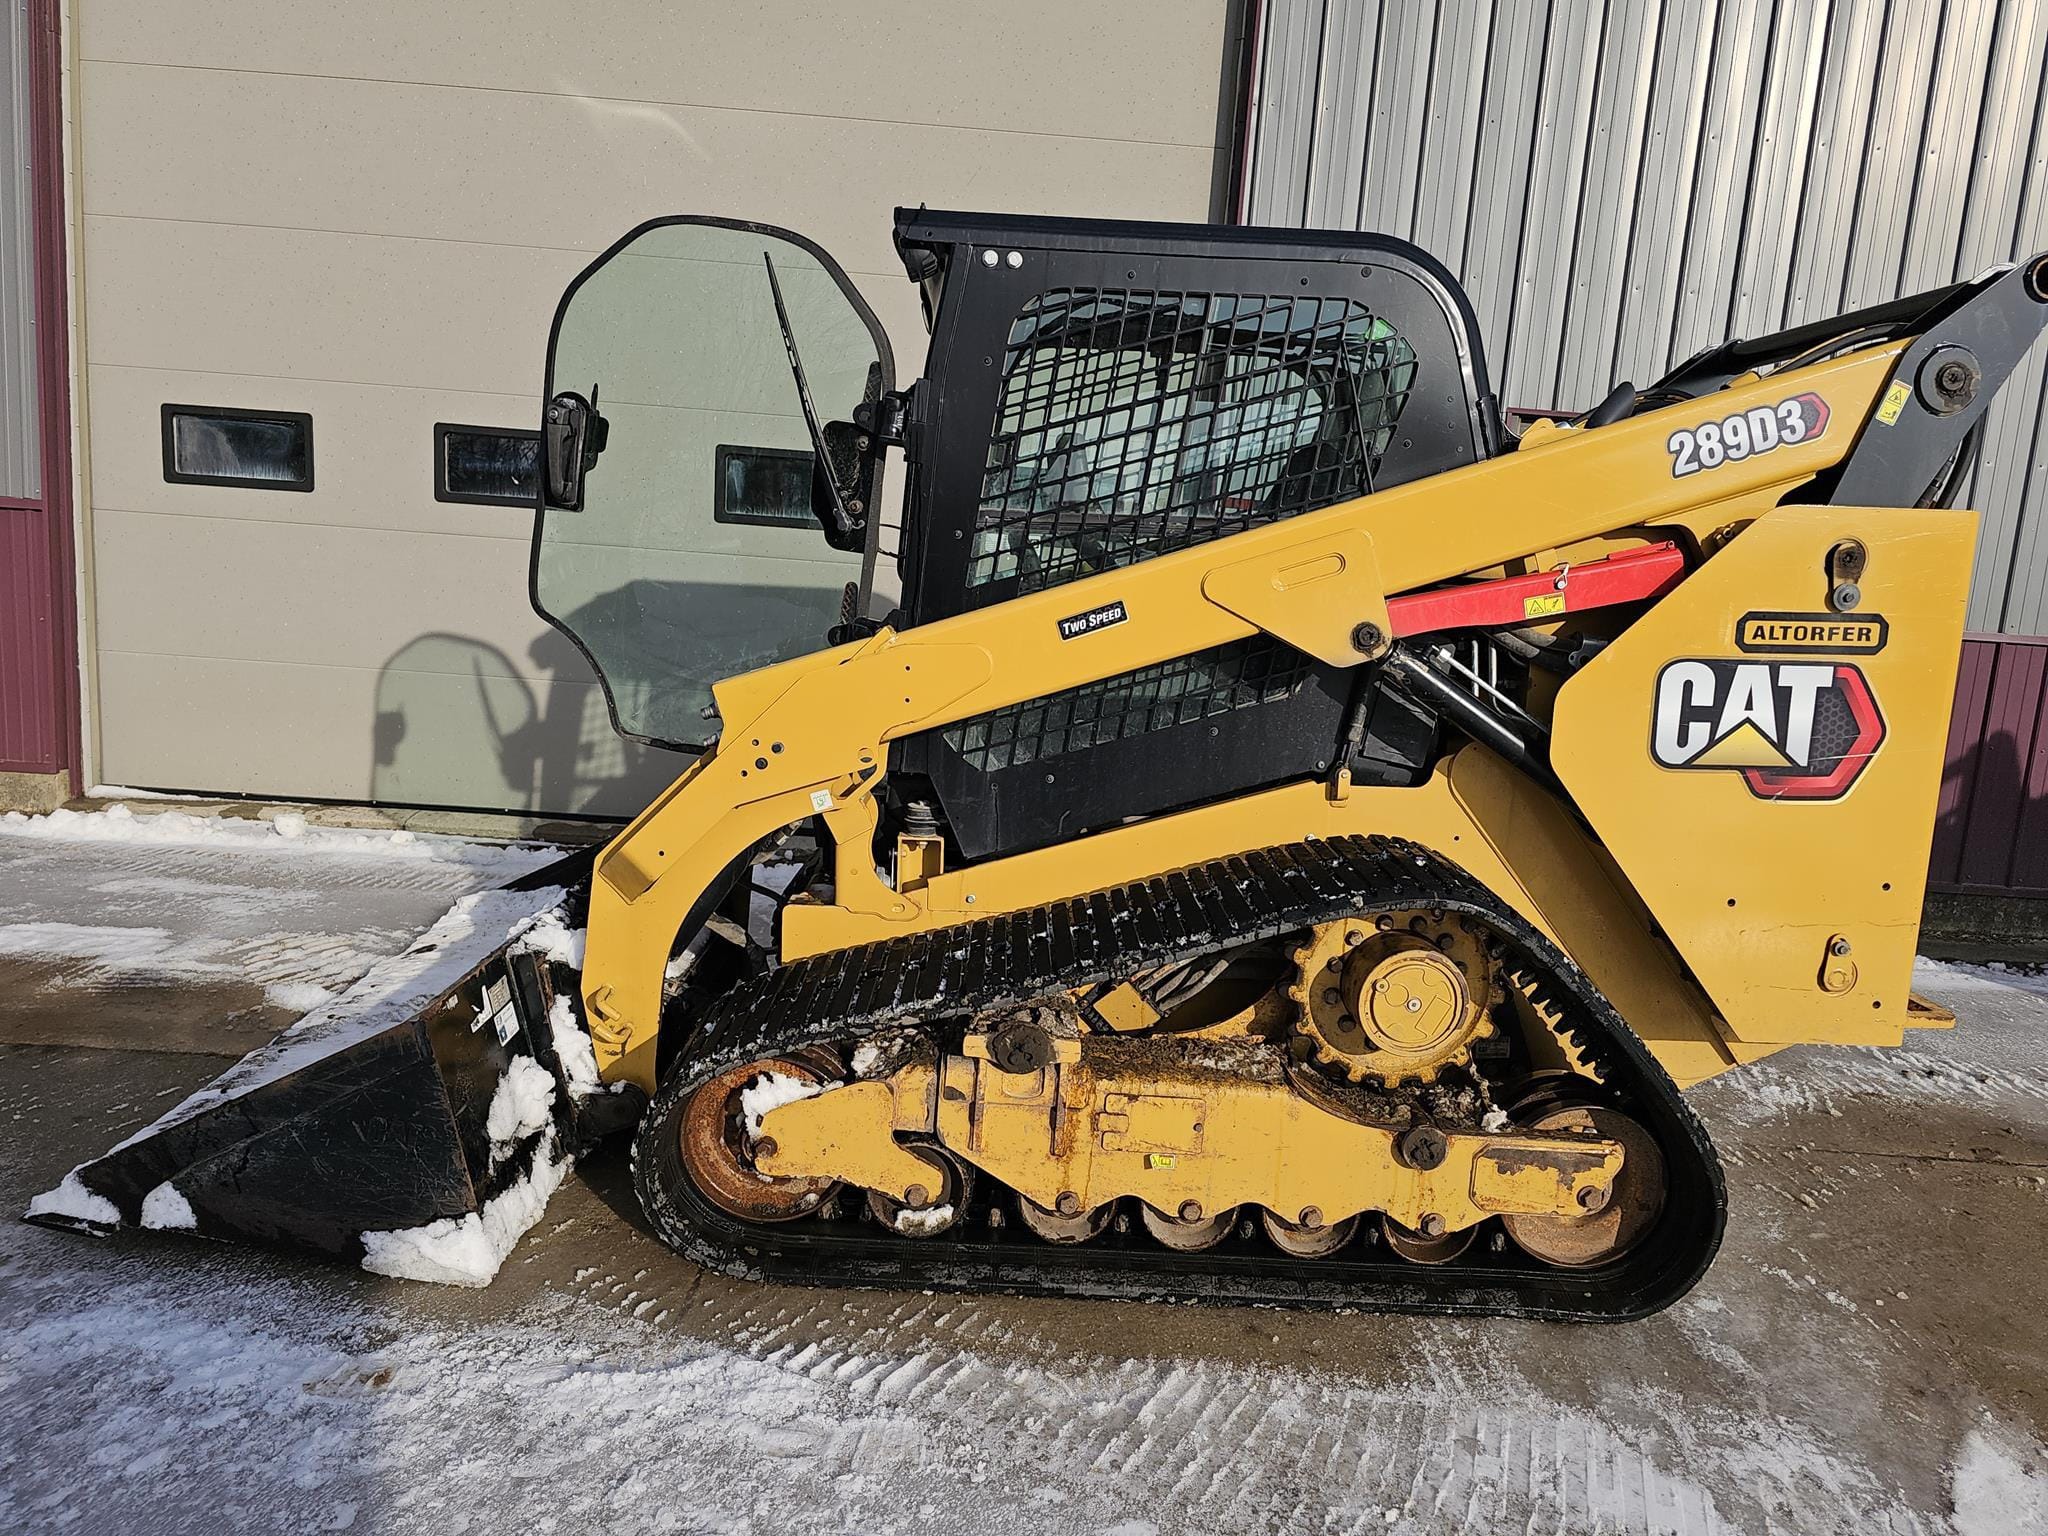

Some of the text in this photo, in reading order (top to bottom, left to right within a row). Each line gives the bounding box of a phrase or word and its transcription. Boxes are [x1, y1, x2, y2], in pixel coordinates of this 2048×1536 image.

[1669, 400, 1806, 476] 289D3
[1062, 608, 1121, 635] TWO SPEED
[1751, 625, 1872, 642] ALTORFER
[1655, 661, 1834, 767] CAT
